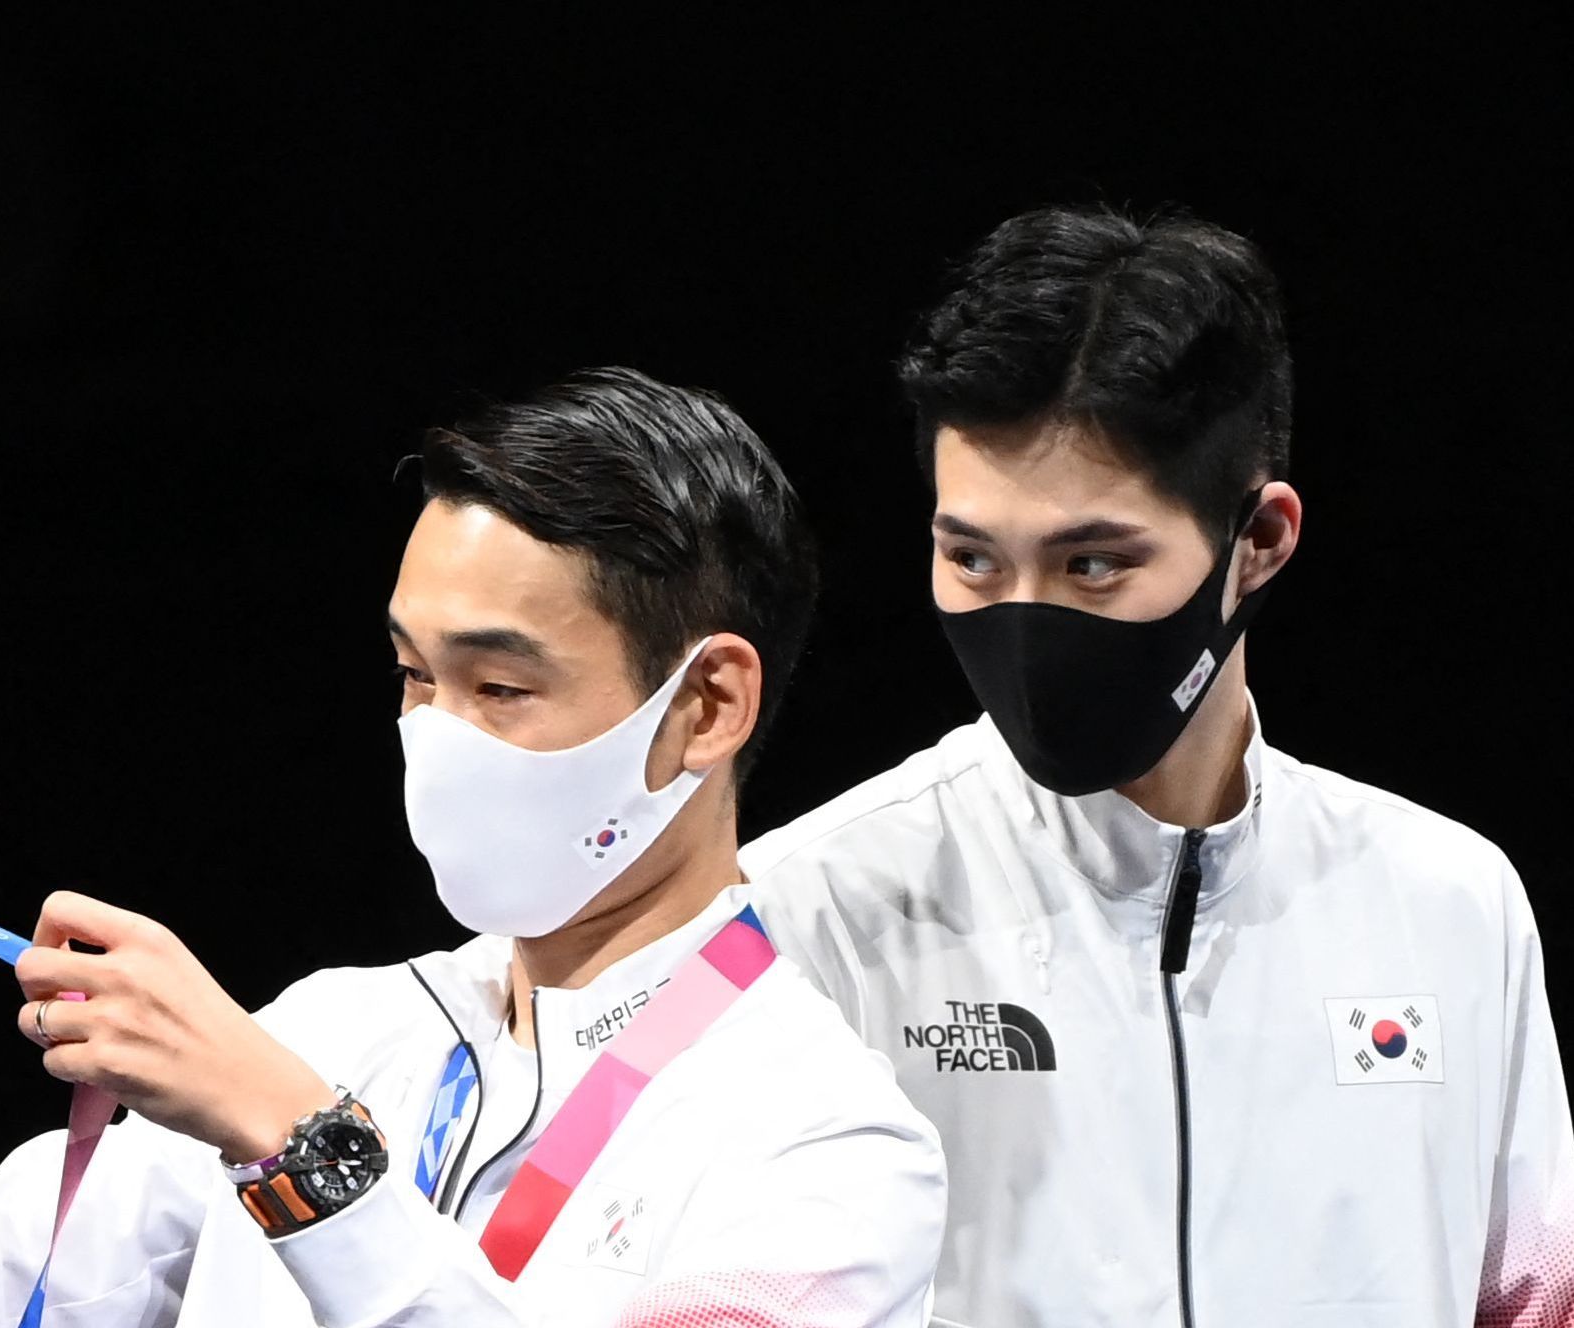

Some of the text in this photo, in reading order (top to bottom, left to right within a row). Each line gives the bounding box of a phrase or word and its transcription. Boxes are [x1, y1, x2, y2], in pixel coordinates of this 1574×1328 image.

[945, 1000, 998, 1024] THE
[903, 1024, 1002, 1048] NORTH
[936, 1048, 1007, 1072] FACE
